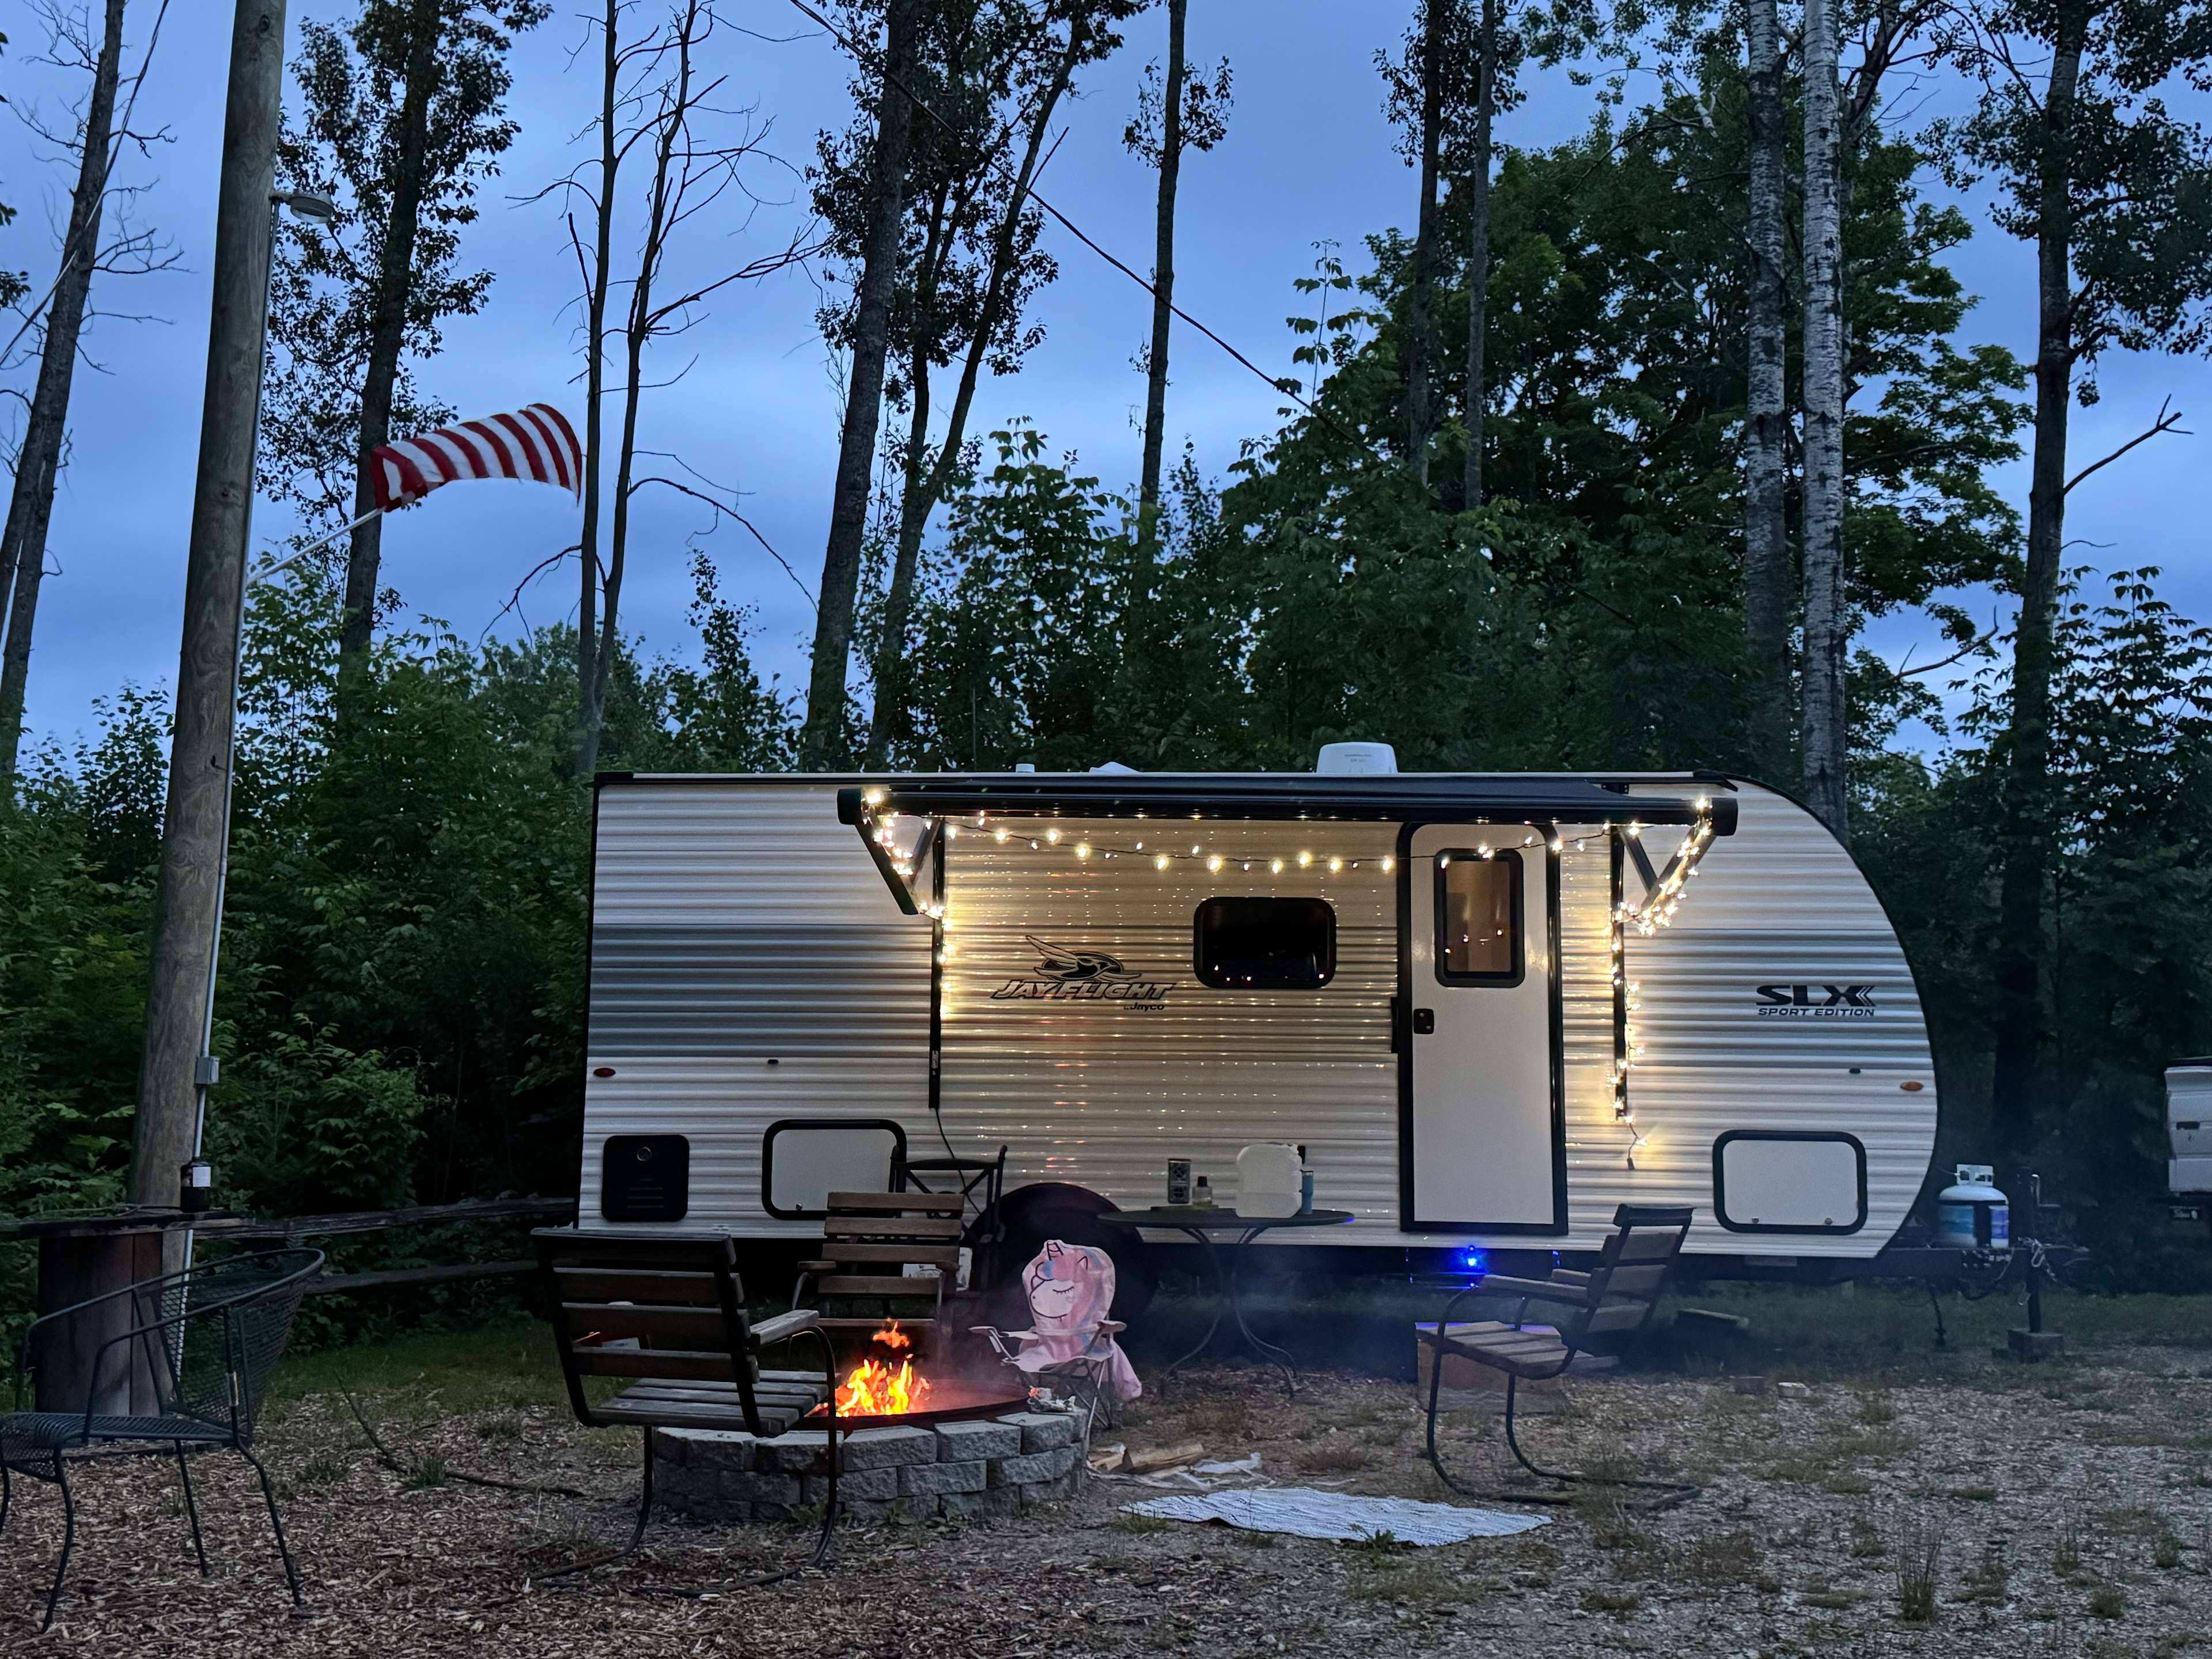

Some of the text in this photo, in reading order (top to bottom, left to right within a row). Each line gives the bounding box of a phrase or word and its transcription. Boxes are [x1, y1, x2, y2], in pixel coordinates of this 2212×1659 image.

[1756, 985, 1876, 1007] SLX
[1130, 1002, 1165, 1012] Jayco
[1758, 1007, 1875, 1016] SPORT EDITION
